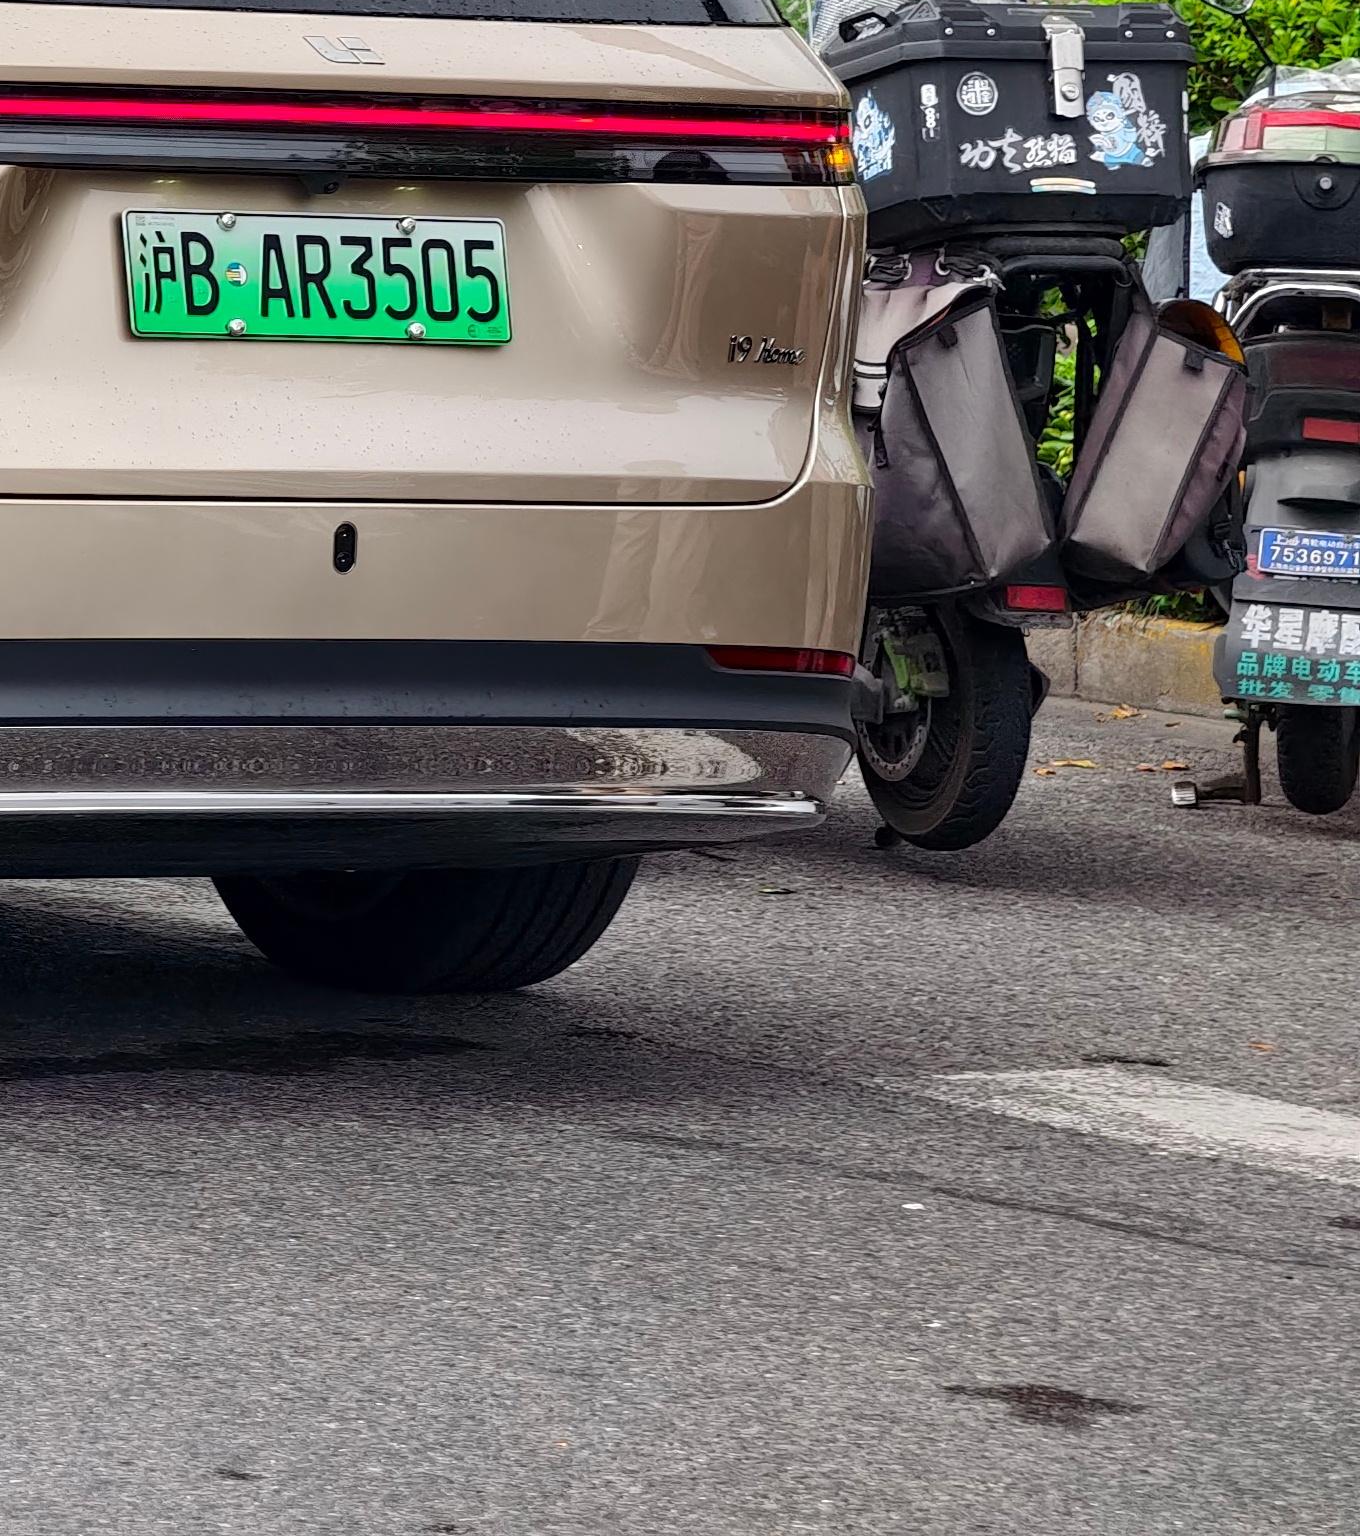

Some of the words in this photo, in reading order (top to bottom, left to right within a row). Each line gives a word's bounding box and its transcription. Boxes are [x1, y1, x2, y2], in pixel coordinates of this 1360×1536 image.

[260, 234, 501, 323] AR3505
[728, 334, 753, 363] i9
[1270, 546, 1359, 565] 7536971
[1237, 651, 1360, 686] 品牌电动车
[1238, 679, 1294, 700] 批发
